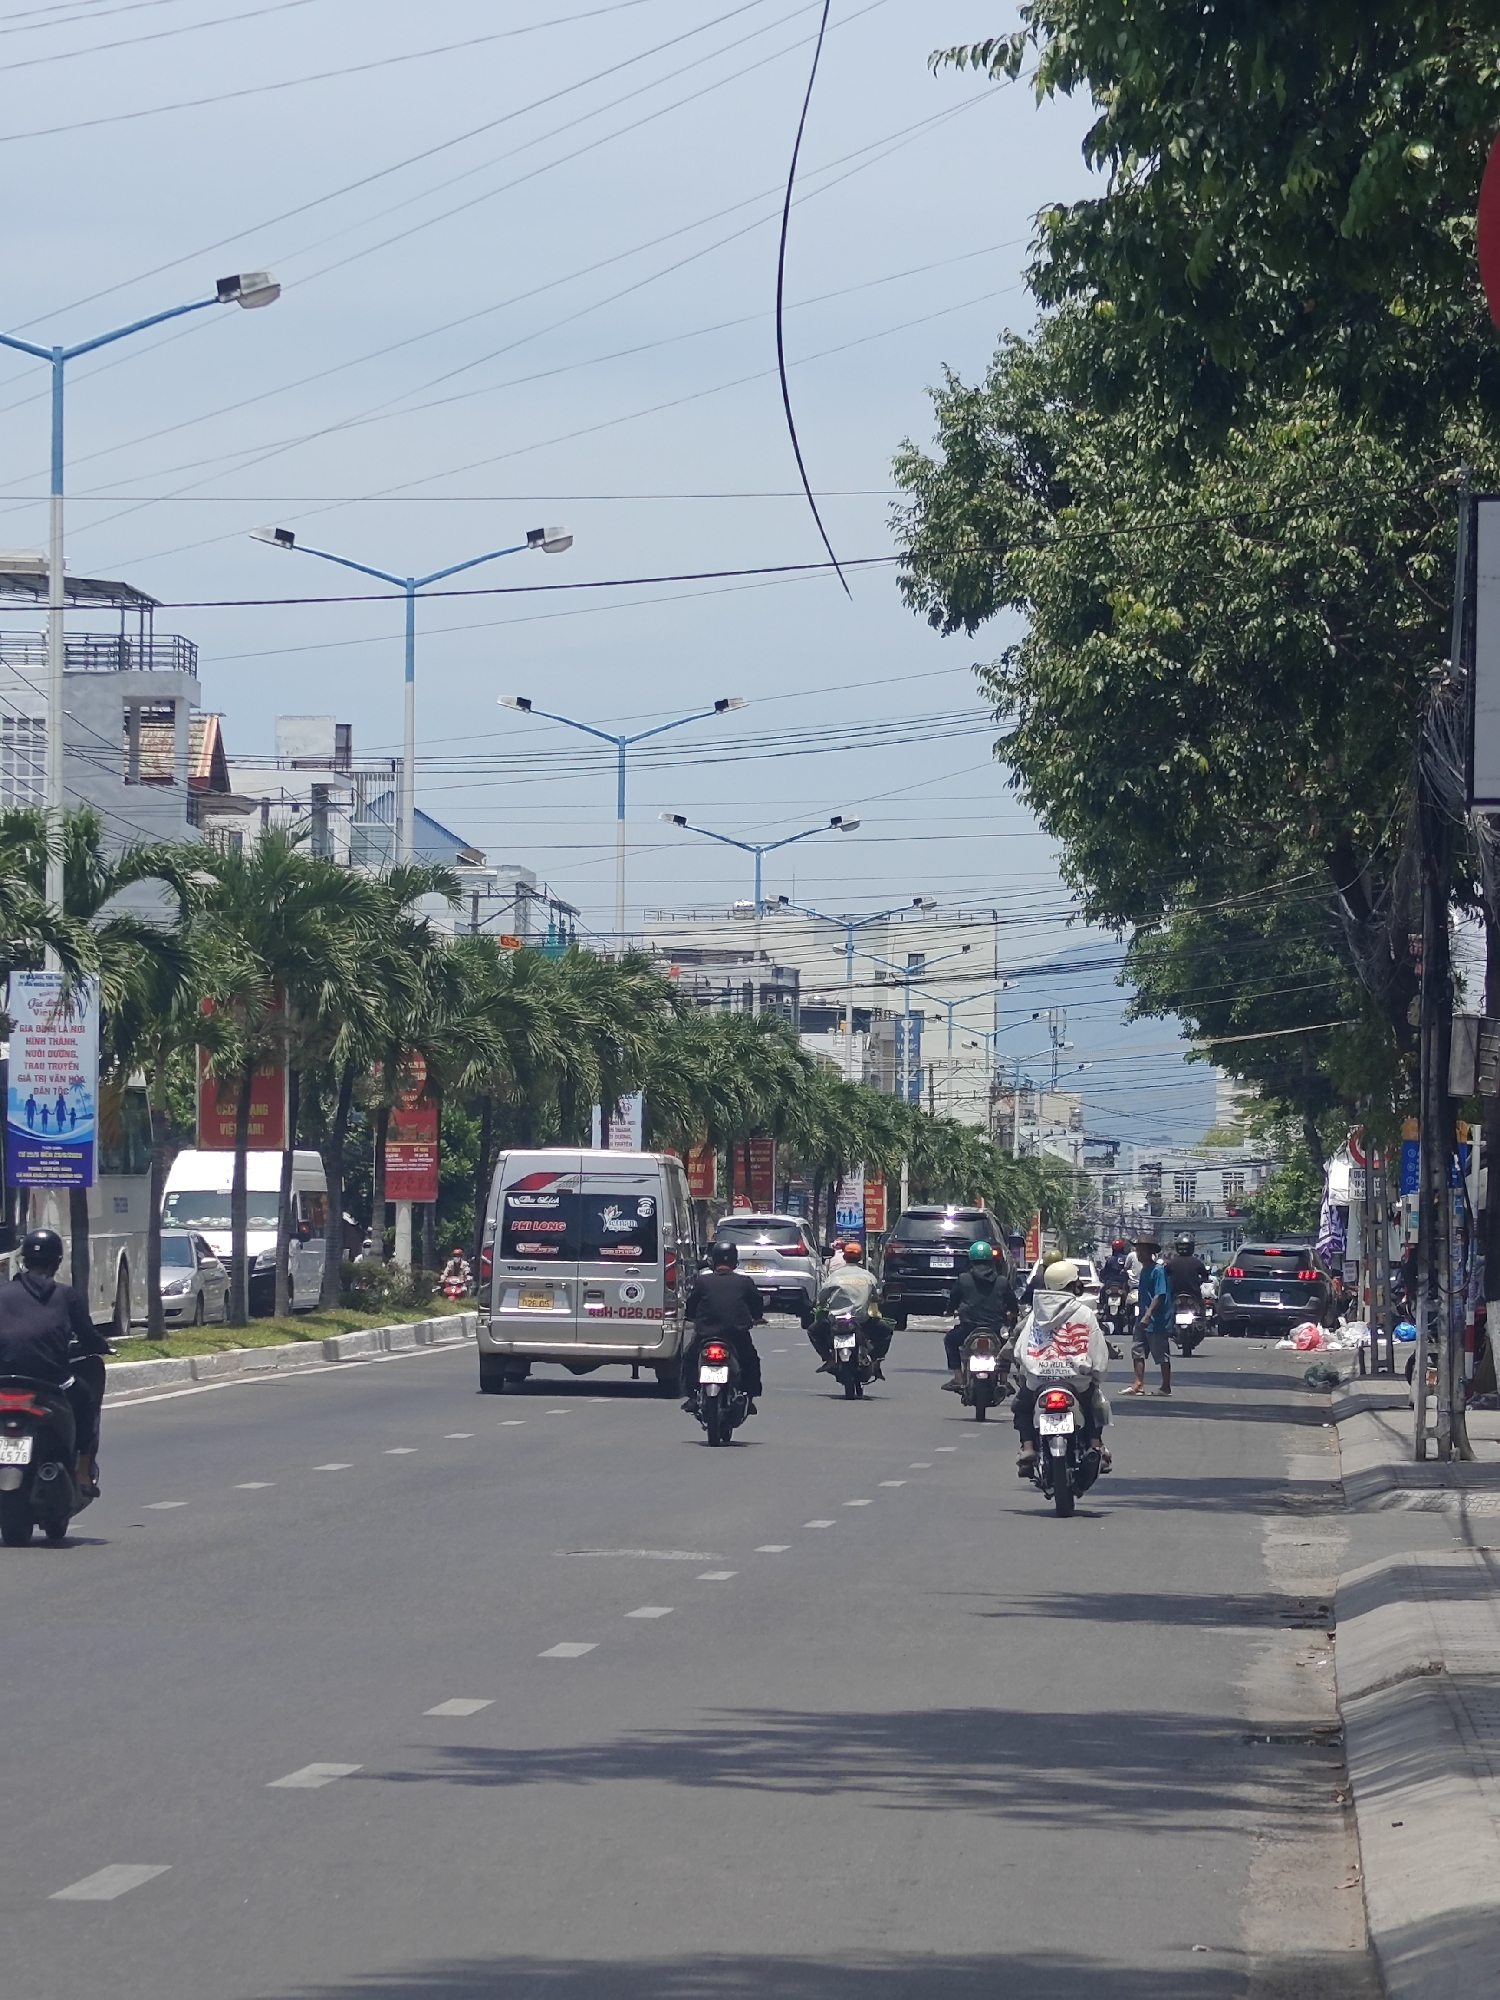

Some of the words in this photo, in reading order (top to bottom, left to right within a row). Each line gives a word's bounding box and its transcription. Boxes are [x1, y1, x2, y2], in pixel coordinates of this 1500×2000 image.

[20, 1025, 33, 1033] GIA
[24, 1062, 45, 1070] TRAO
[17, 1073, 31, 1083] GIÁ
[250, 1103, 269, 1118] ẠNG
[247, 1123, 265, 1135] AM!
[511, 1220, 532, 1231] PHI
[533, 1220, 567, 1232] LONG
